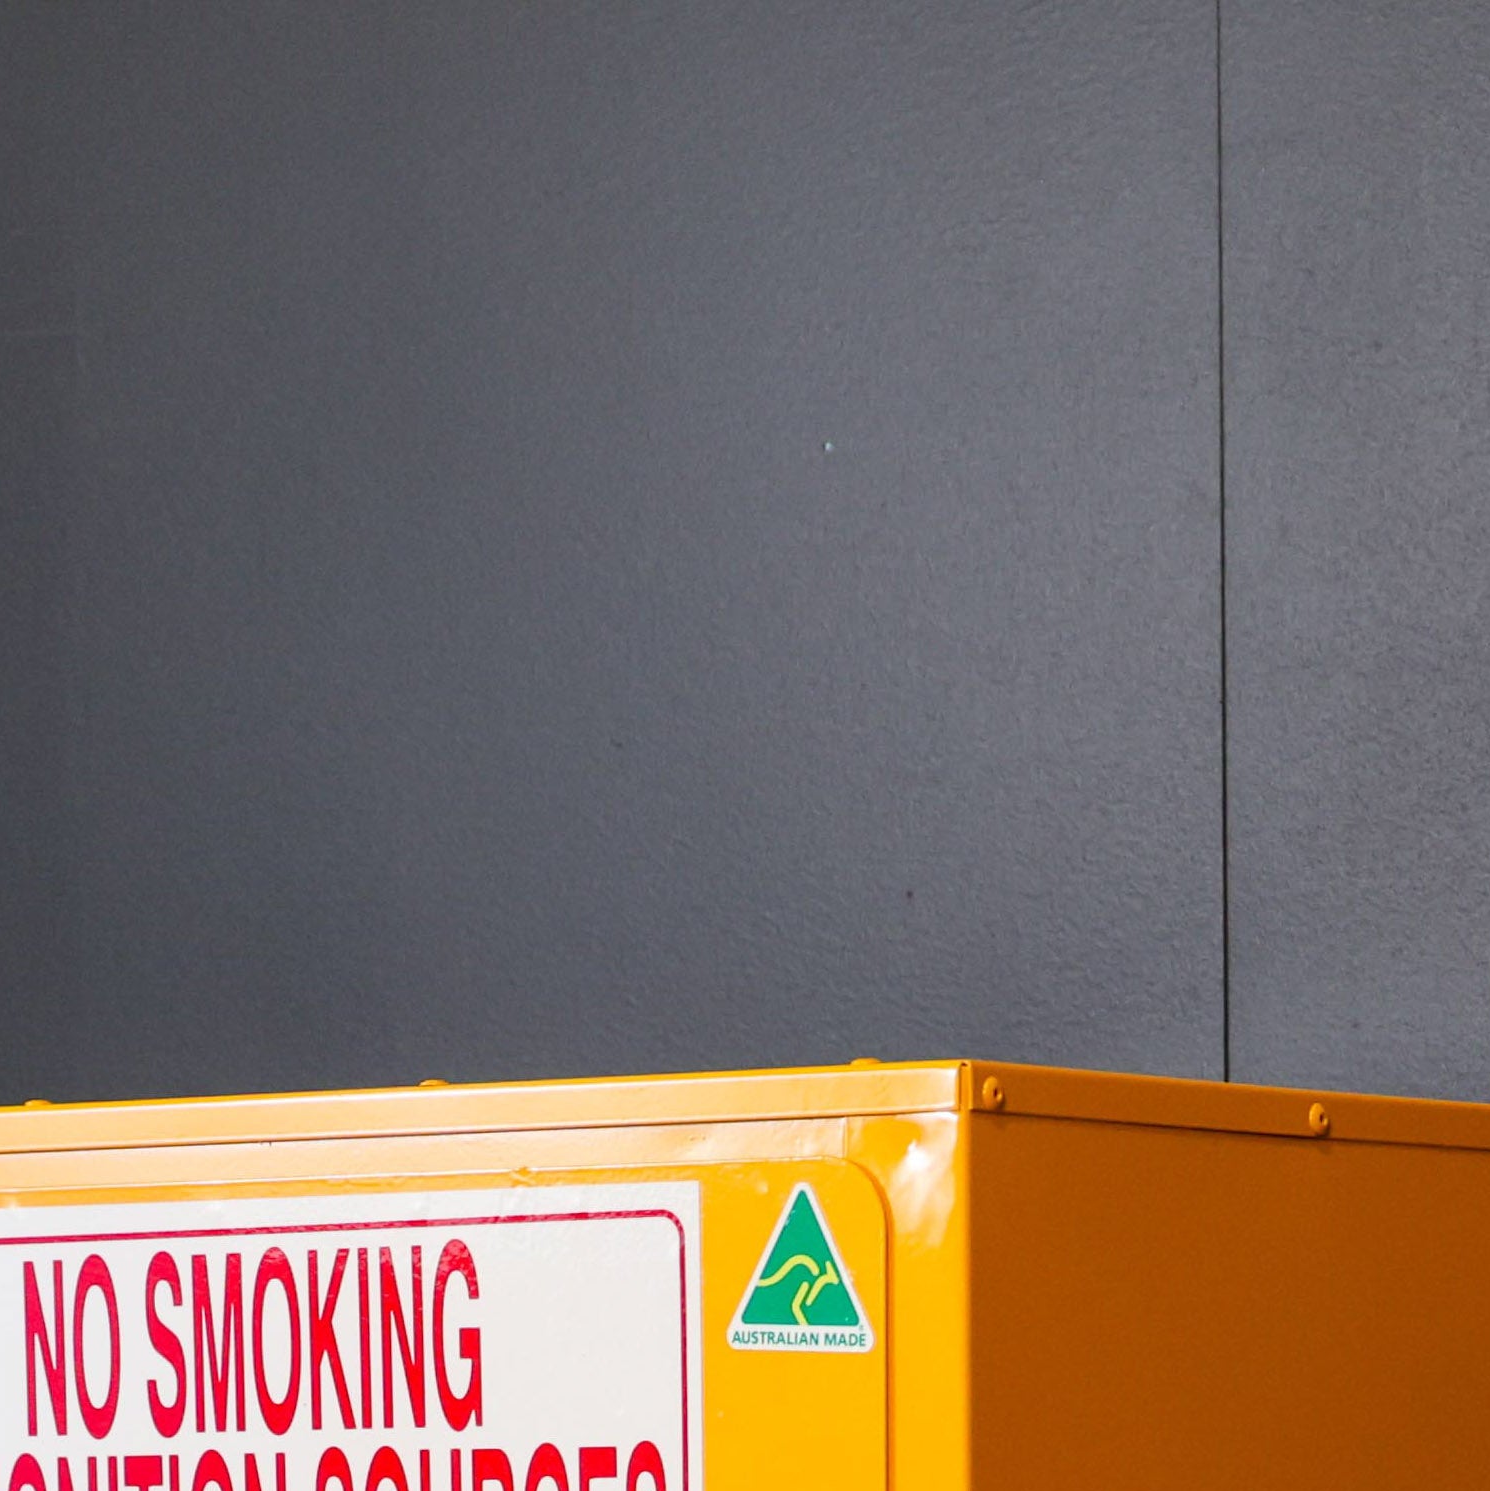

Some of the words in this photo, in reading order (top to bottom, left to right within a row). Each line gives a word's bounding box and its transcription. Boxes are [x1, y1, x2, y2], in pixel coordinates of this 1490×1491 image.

[21, 1253, 120, 1439] NO
[145, 1239, 483, 1438] SMOKING
[731, 1331, 819, 1346] AUSTRALIAN
[824, 1332, 866, 1347] MADE
